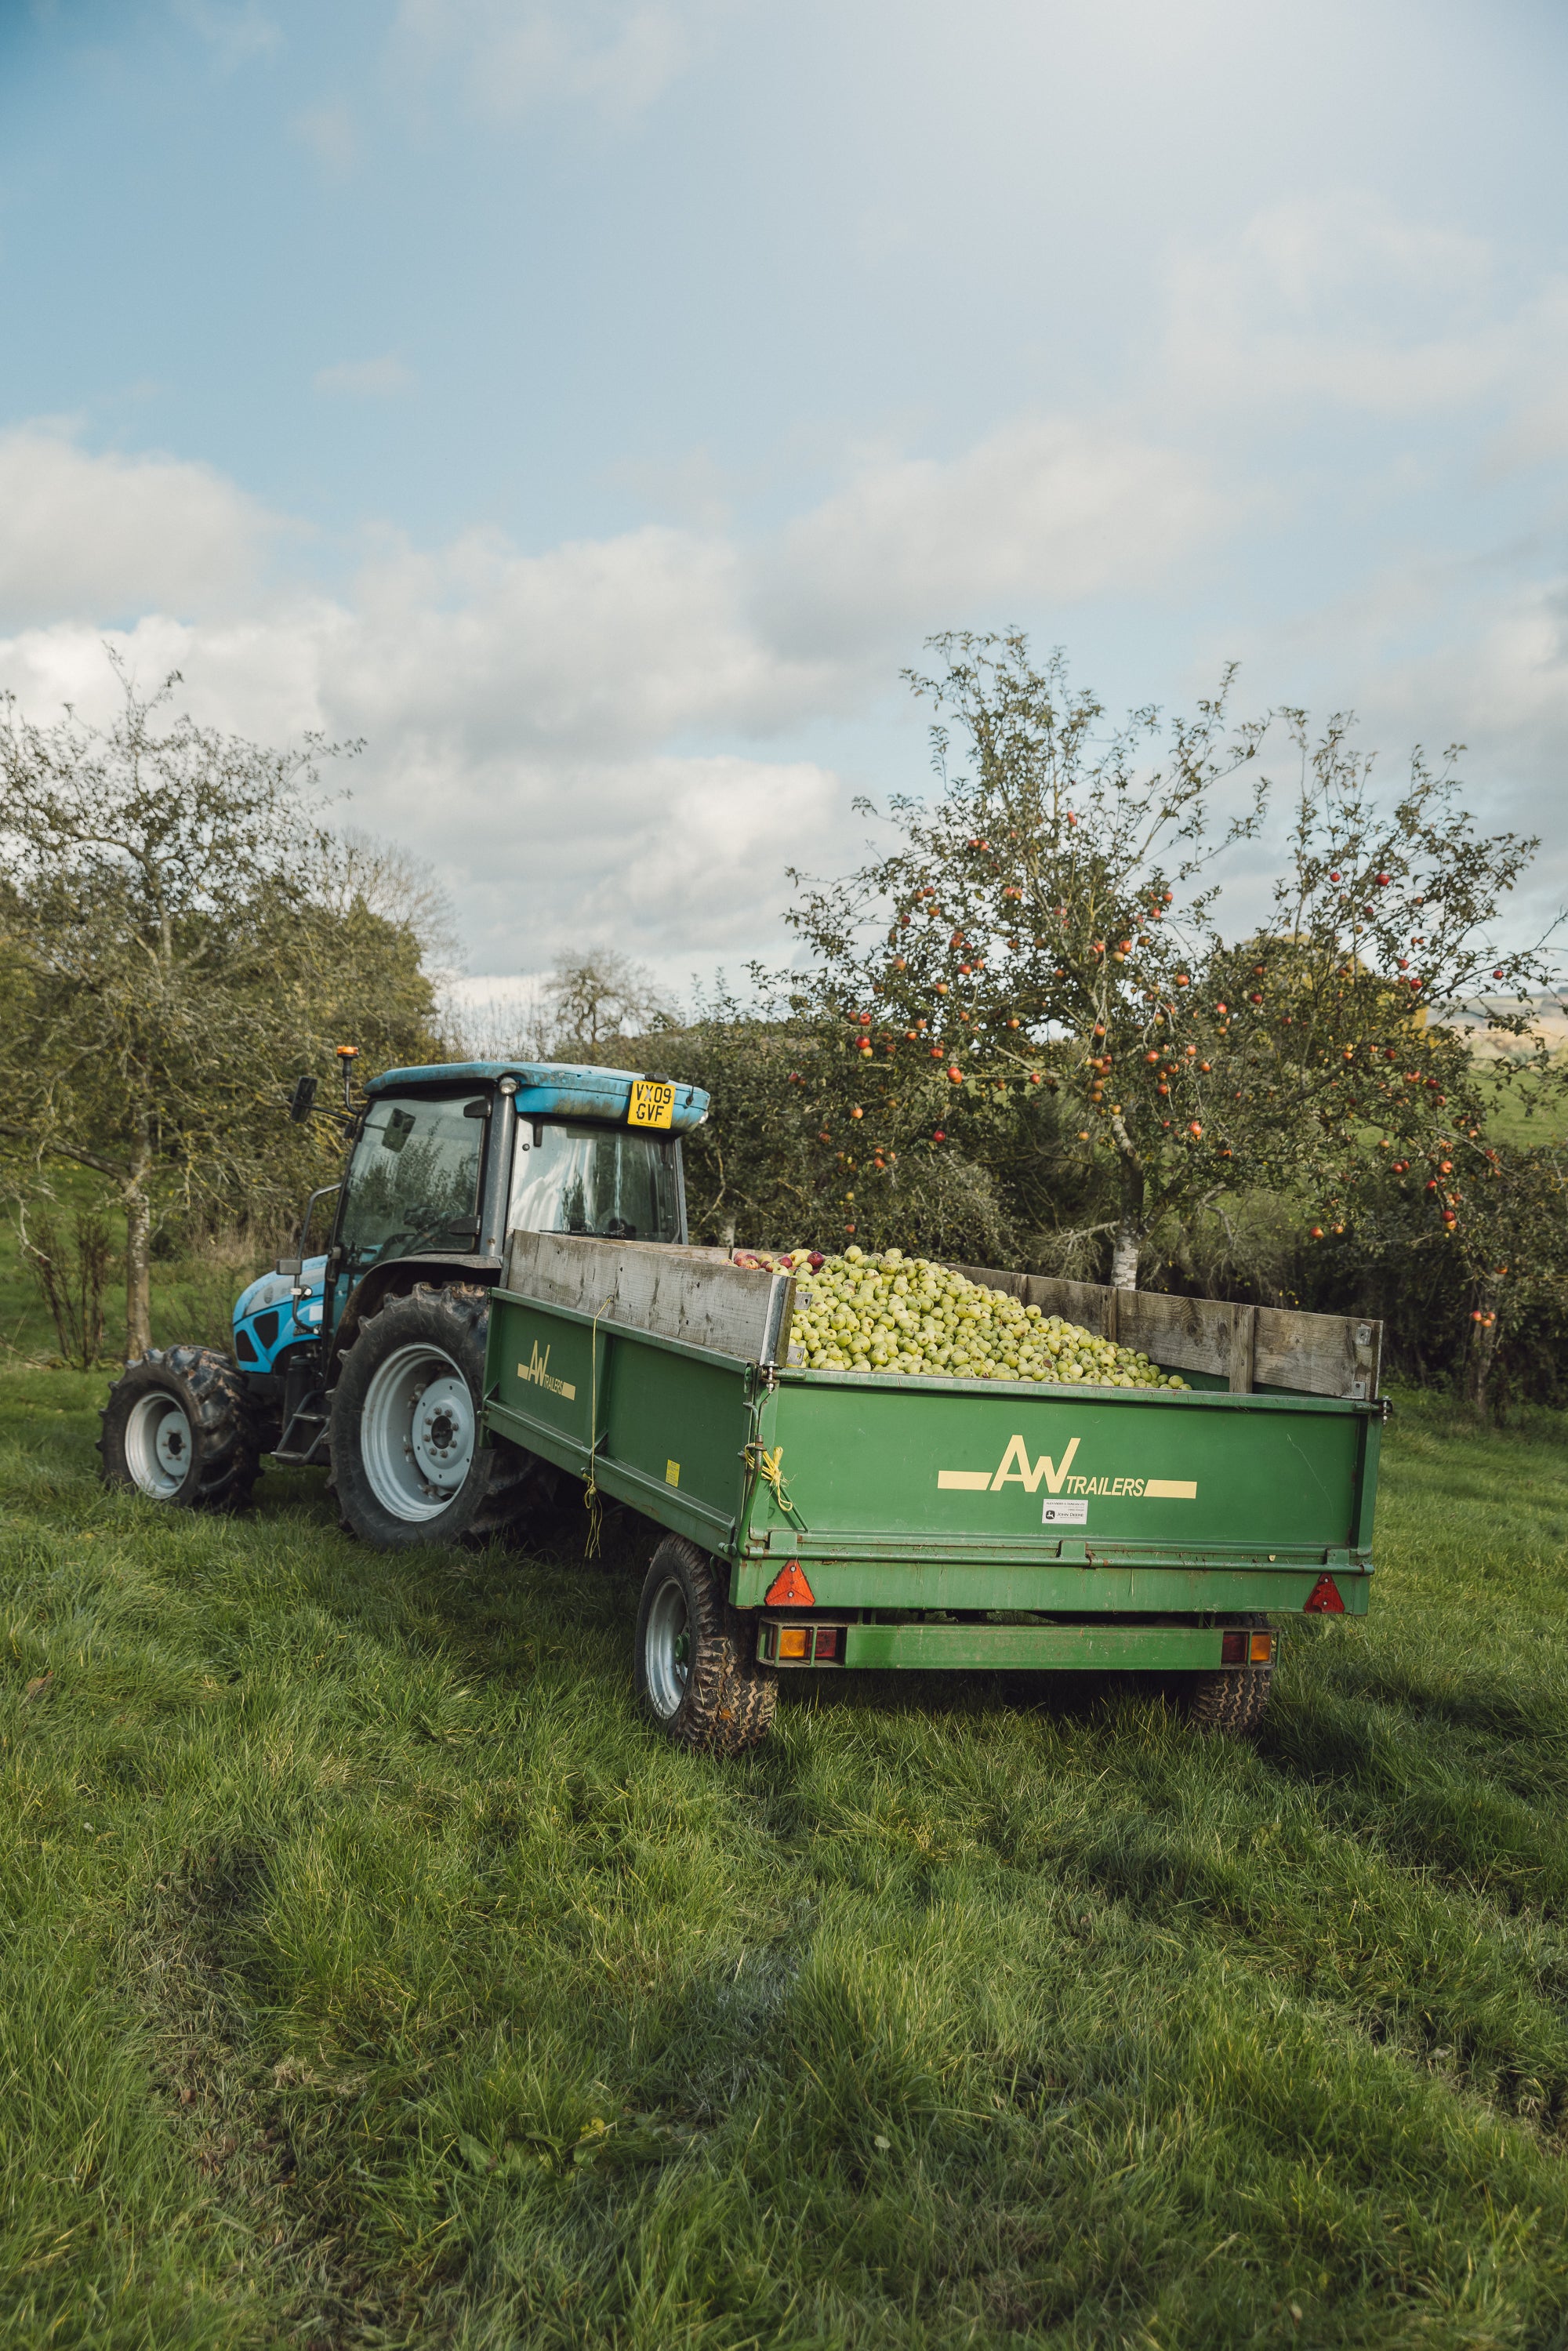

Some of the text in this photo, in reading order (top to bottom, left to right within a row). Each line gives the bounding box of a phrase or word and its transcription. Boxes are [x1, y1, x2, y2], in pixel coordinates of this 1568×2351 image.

[637, 1083, 672, 1104] VX09
[637, 1103, 664, 1121] GVF
[528, 1340, 564, 1395] AW TRAILERS
[989, 1435, 1145, 1497] AW TRAILERS
